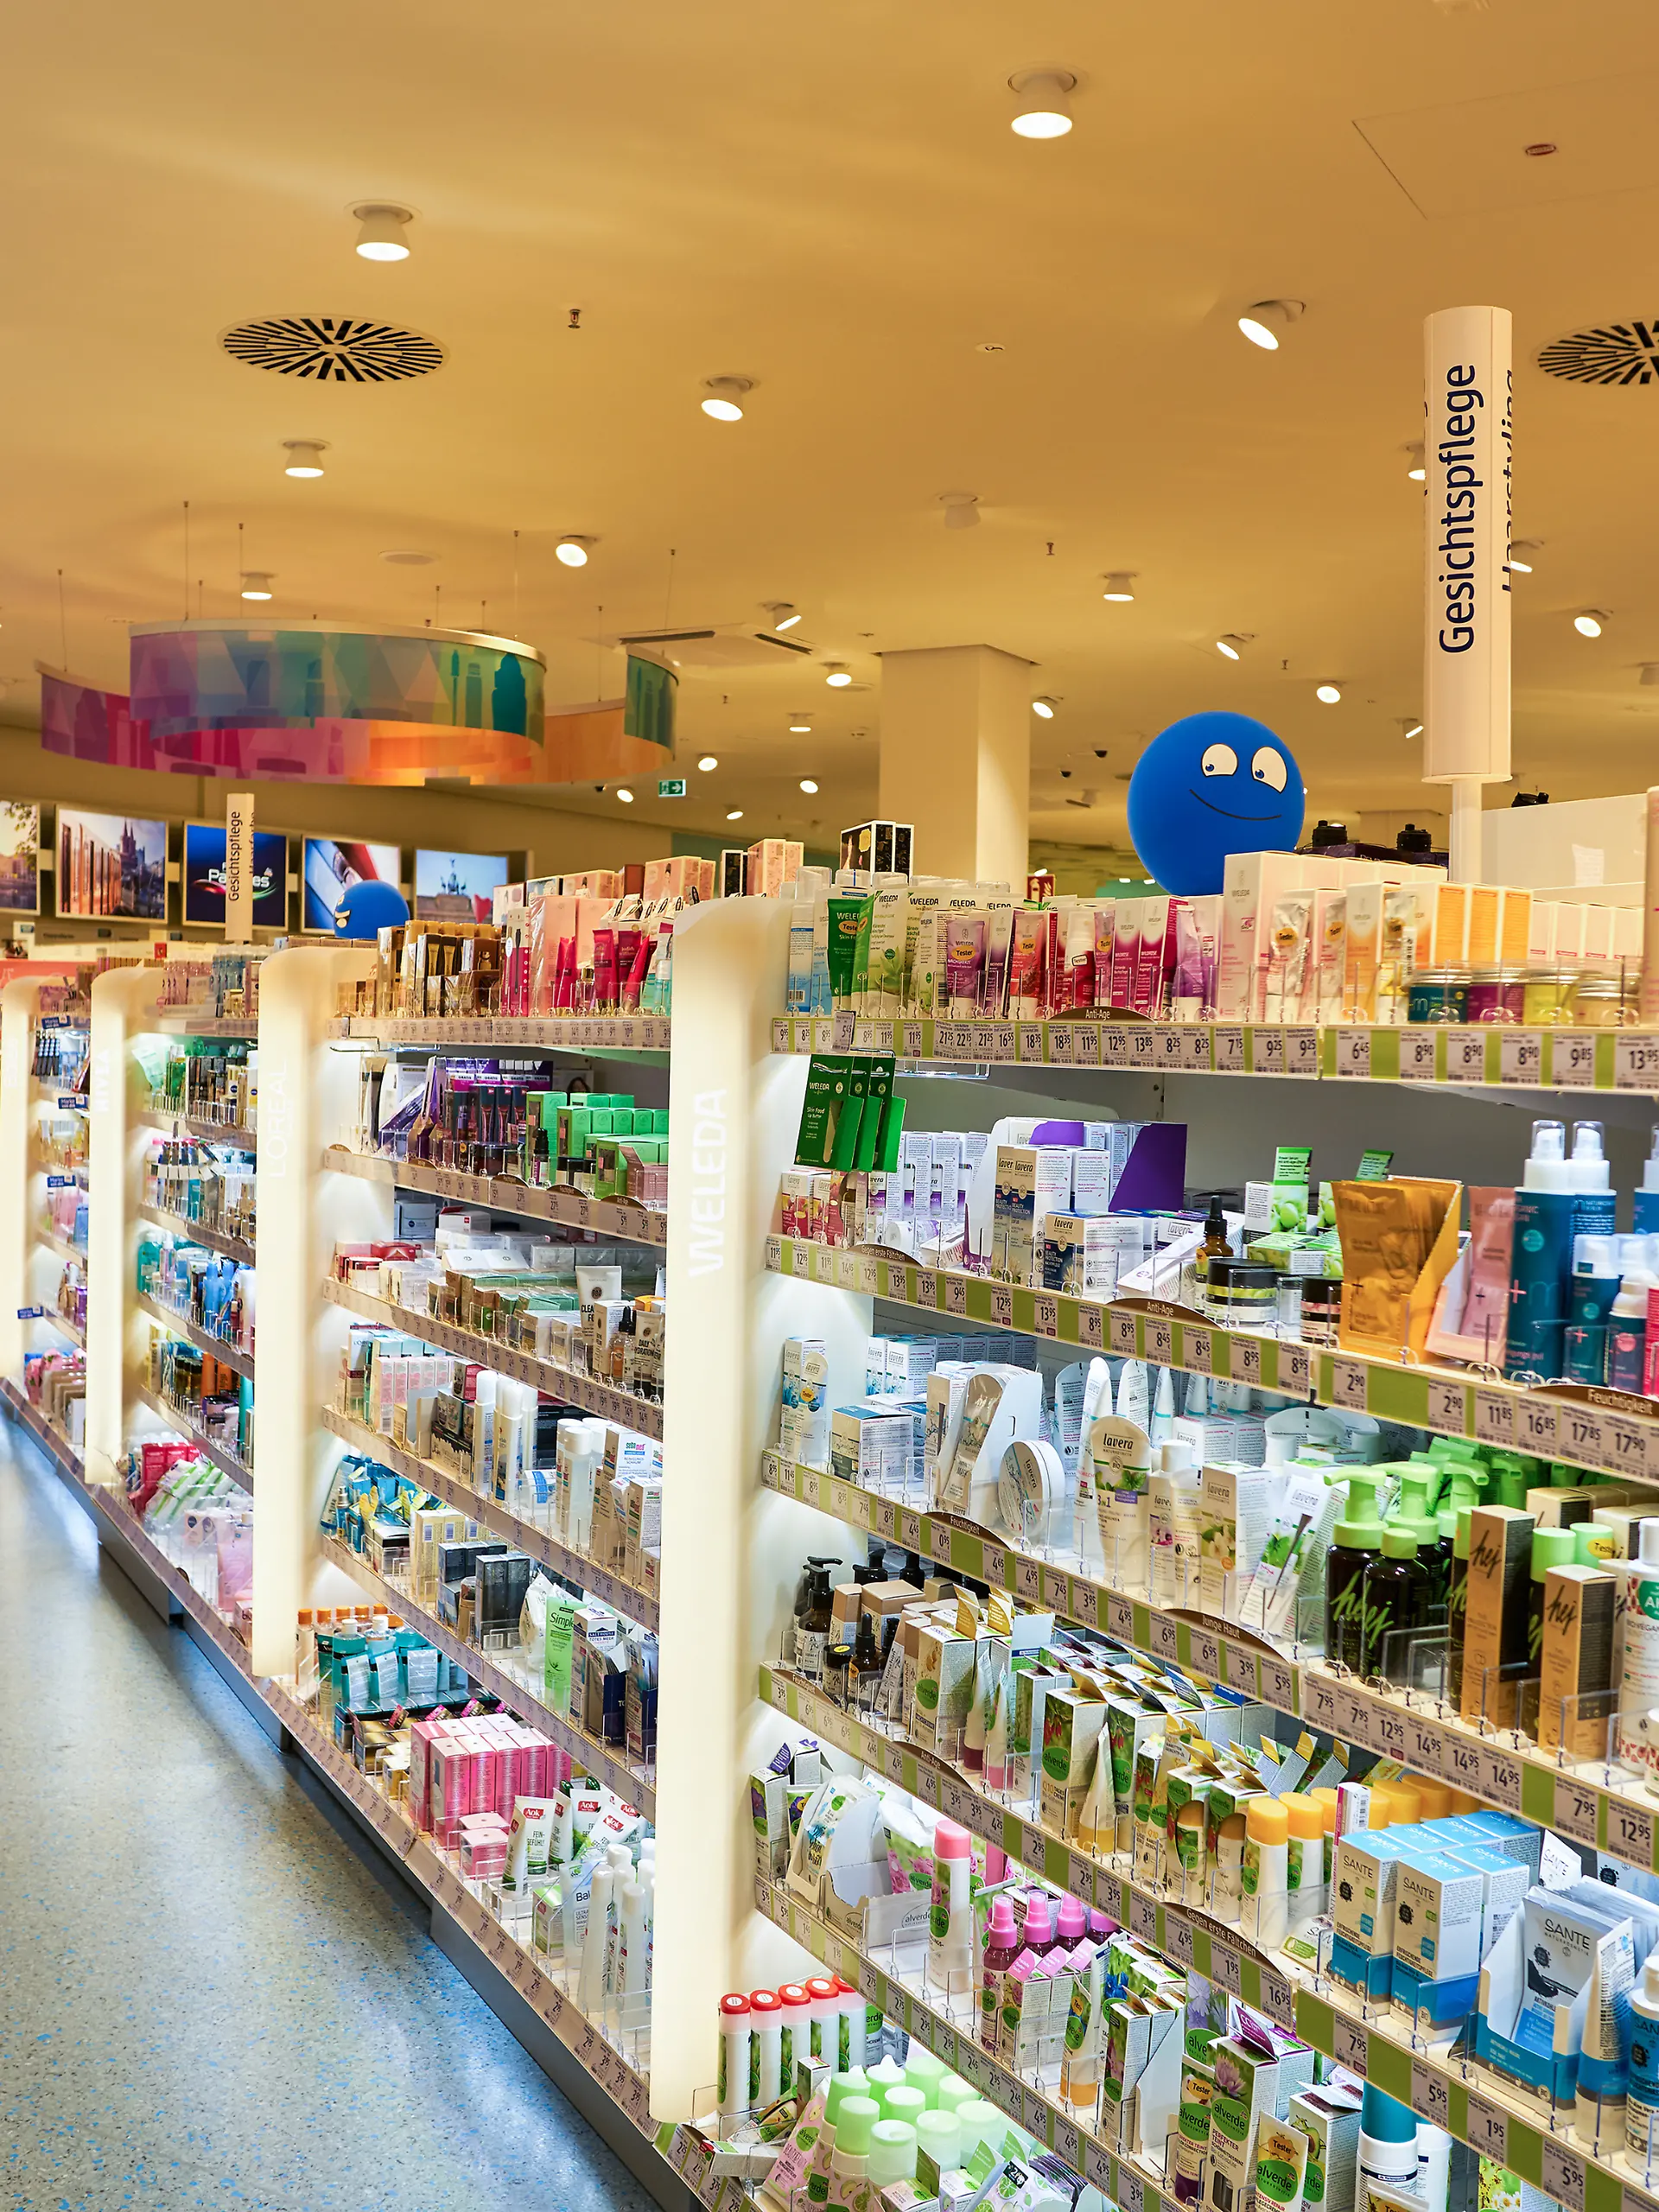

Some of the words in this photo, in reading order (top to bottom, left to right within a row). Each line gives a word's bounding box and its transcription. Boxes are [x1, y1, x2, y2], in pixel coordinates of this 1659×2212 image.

[1439, 365, 1484, 653] Gesichtspflege
[228, 811, 243, 901] Gesichtspflege
[1086, 1009, 1109, 1020] Anti-Age
[999, 1158, 1014, 1168] laver
[1015, 1162, 1033, 1173] lavera
[689, 1089, 727, 1277] WELEDA
[1054, 1217, 1073, 1229] lavera
[861, 1245, 874, 1255] Gegen
[1147, 1301, 1174, 1317] Anti-Age
[1587, 1389, 1653, 1415] Feuchtigkeit
[1103, 1433, 1134, 1450] lavera
[1208, 1483, 1230, 1497] lavera
[950, 1516, 981, 1535] Feuchtigkeit
[1470, 1529, 1503, 1580] hej
[1546, 1585, 1577, 1636] hej
[1202, 1615, 1221, 1631] Junge
[1222, 1622, 1240, 1639] Haut
[1044, 1752, 1067, 1771] alverde
[525, 1808, 539, 1817] Aok
[622, 1805, 636, 1815] Aok
[1366, 1834, 1402, 1853] SANTE
[1344, 1855, 1373, 1878] SANTE
[1542, 1849, 1568, 1876] SANTE
[1403, 1877, 1435, 1901] SANTE
[906, 1911, 931, 1924] alverde
[1186, 1909, 1210, 1929] Gegen
[1209, 1920, 1228, 1940] erste
[1226, 1928, 1258, 1958] Fältchen
[1545, 1918, 1591, 1950] SANTE
[1192, 2083, 1211, 2095] Tester
[1179, 2108, 1210, 2129] alverde
[1214, 2103, 1245, 2130] alverde
[1212, 2129, 1239, 2152] PERFEKTER
[1212, 2137, 1225, 2147] TEINT
[1273, 2140, 1292, 2153] Tester
[1257, 2164, 1292, 2191] alverde
